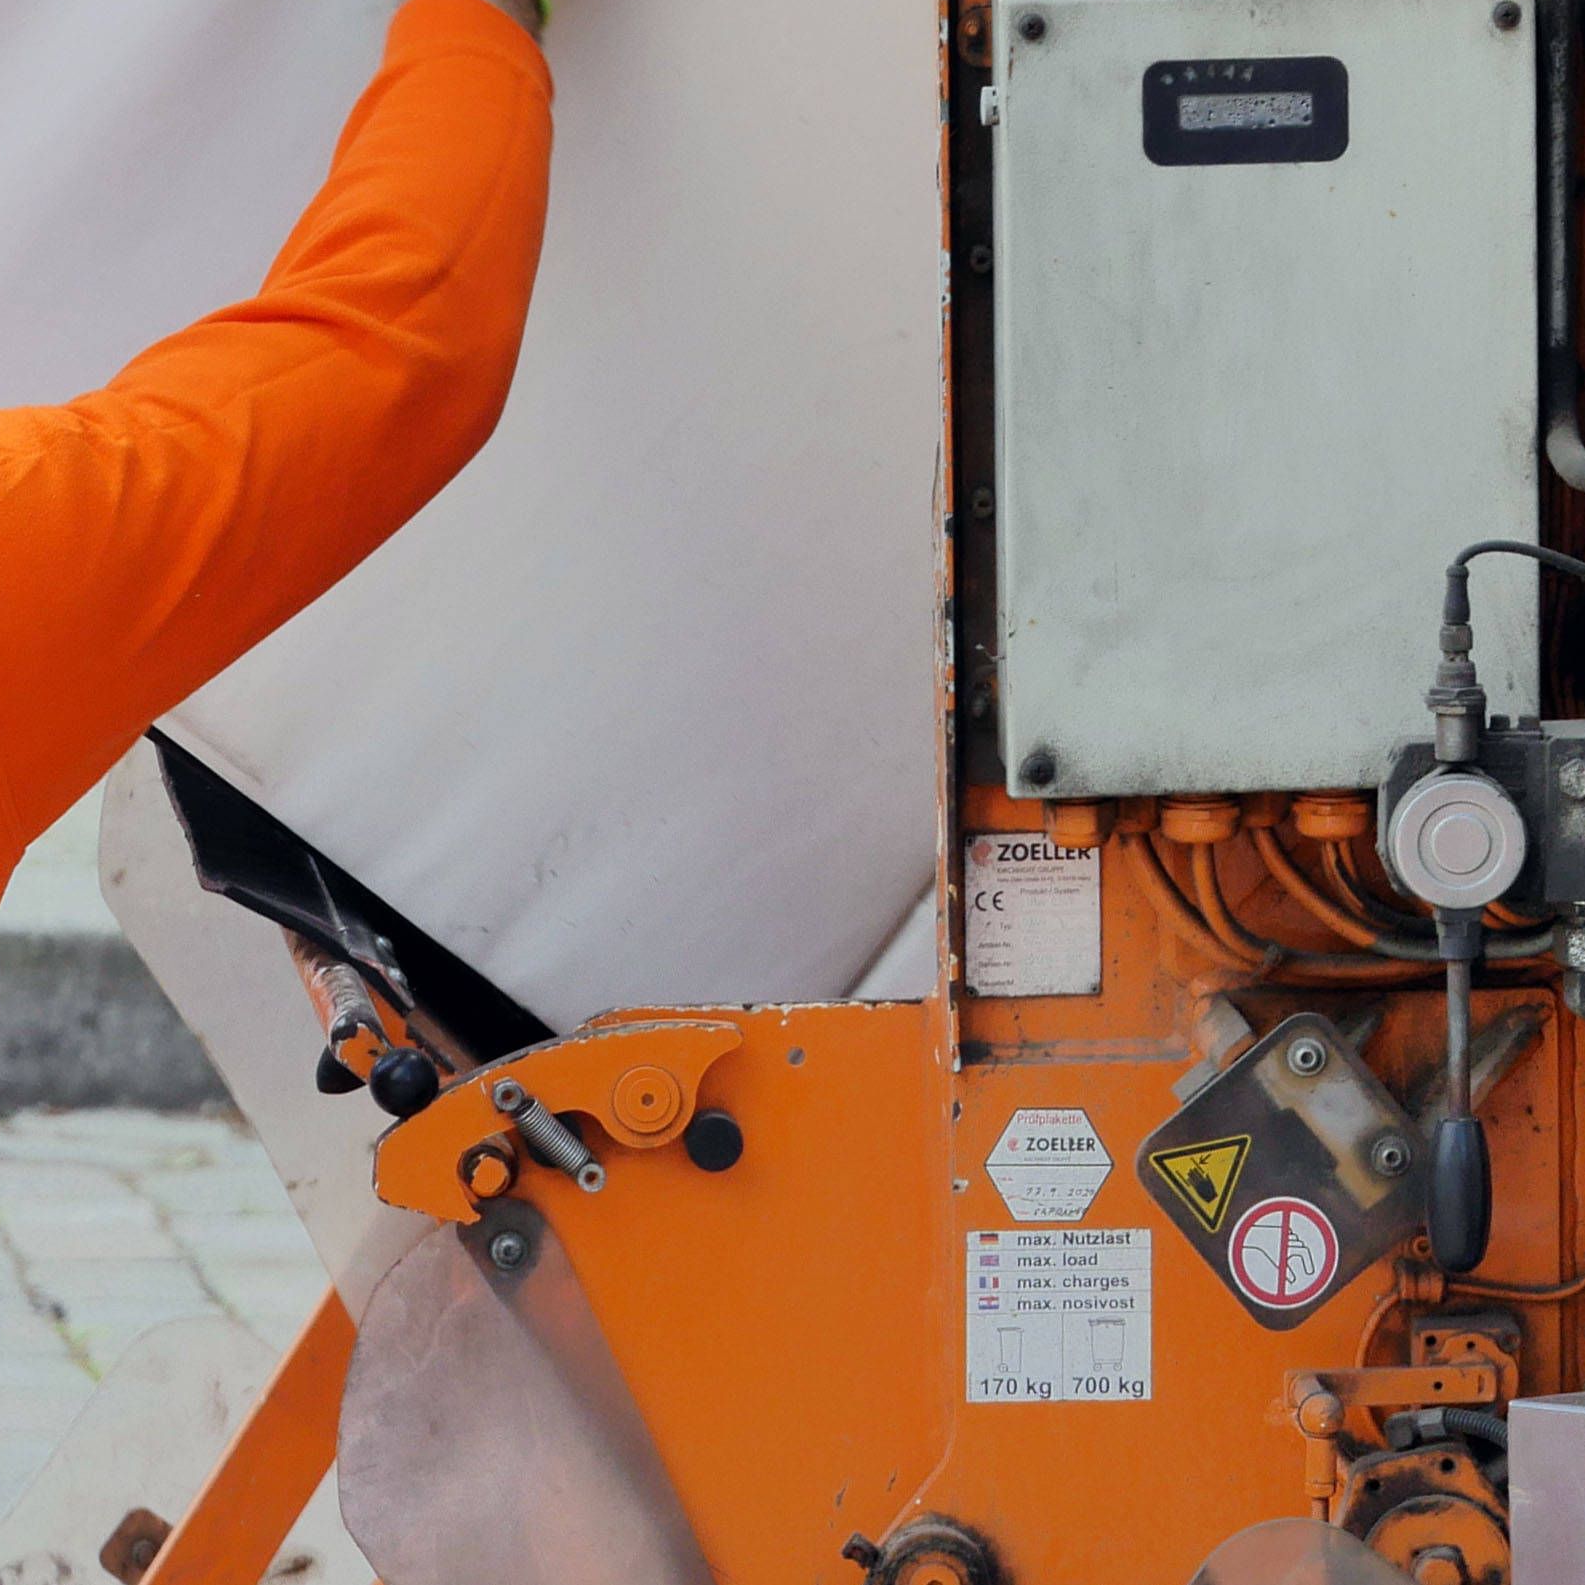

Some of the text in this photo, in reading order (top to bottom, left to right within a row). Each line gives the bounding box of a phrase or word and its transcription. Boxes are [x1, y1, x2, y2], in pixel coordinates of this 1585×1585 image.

[996, 842, 1092, 862] ZOELLER
[975, 890, 1004, 912] CE
[1016, 1112, 1083, 1126] Prüfplakette
[1025, 1137, 1096, 1152] ZOELLER
[1016, 1231, 1132, 1247] max. Nutzlast
[1016, 1252, 1099, 1267] max. load
[1016, 1274, 1130, 1291] max. charges
[1016, 1296, 1136, 1310] max. nosivost
[980, 1378, 1018, 1395] 170
[1026, 1377, 1053, 1399] kg
[1072, 1376, 1145, 1397] 700 kg
